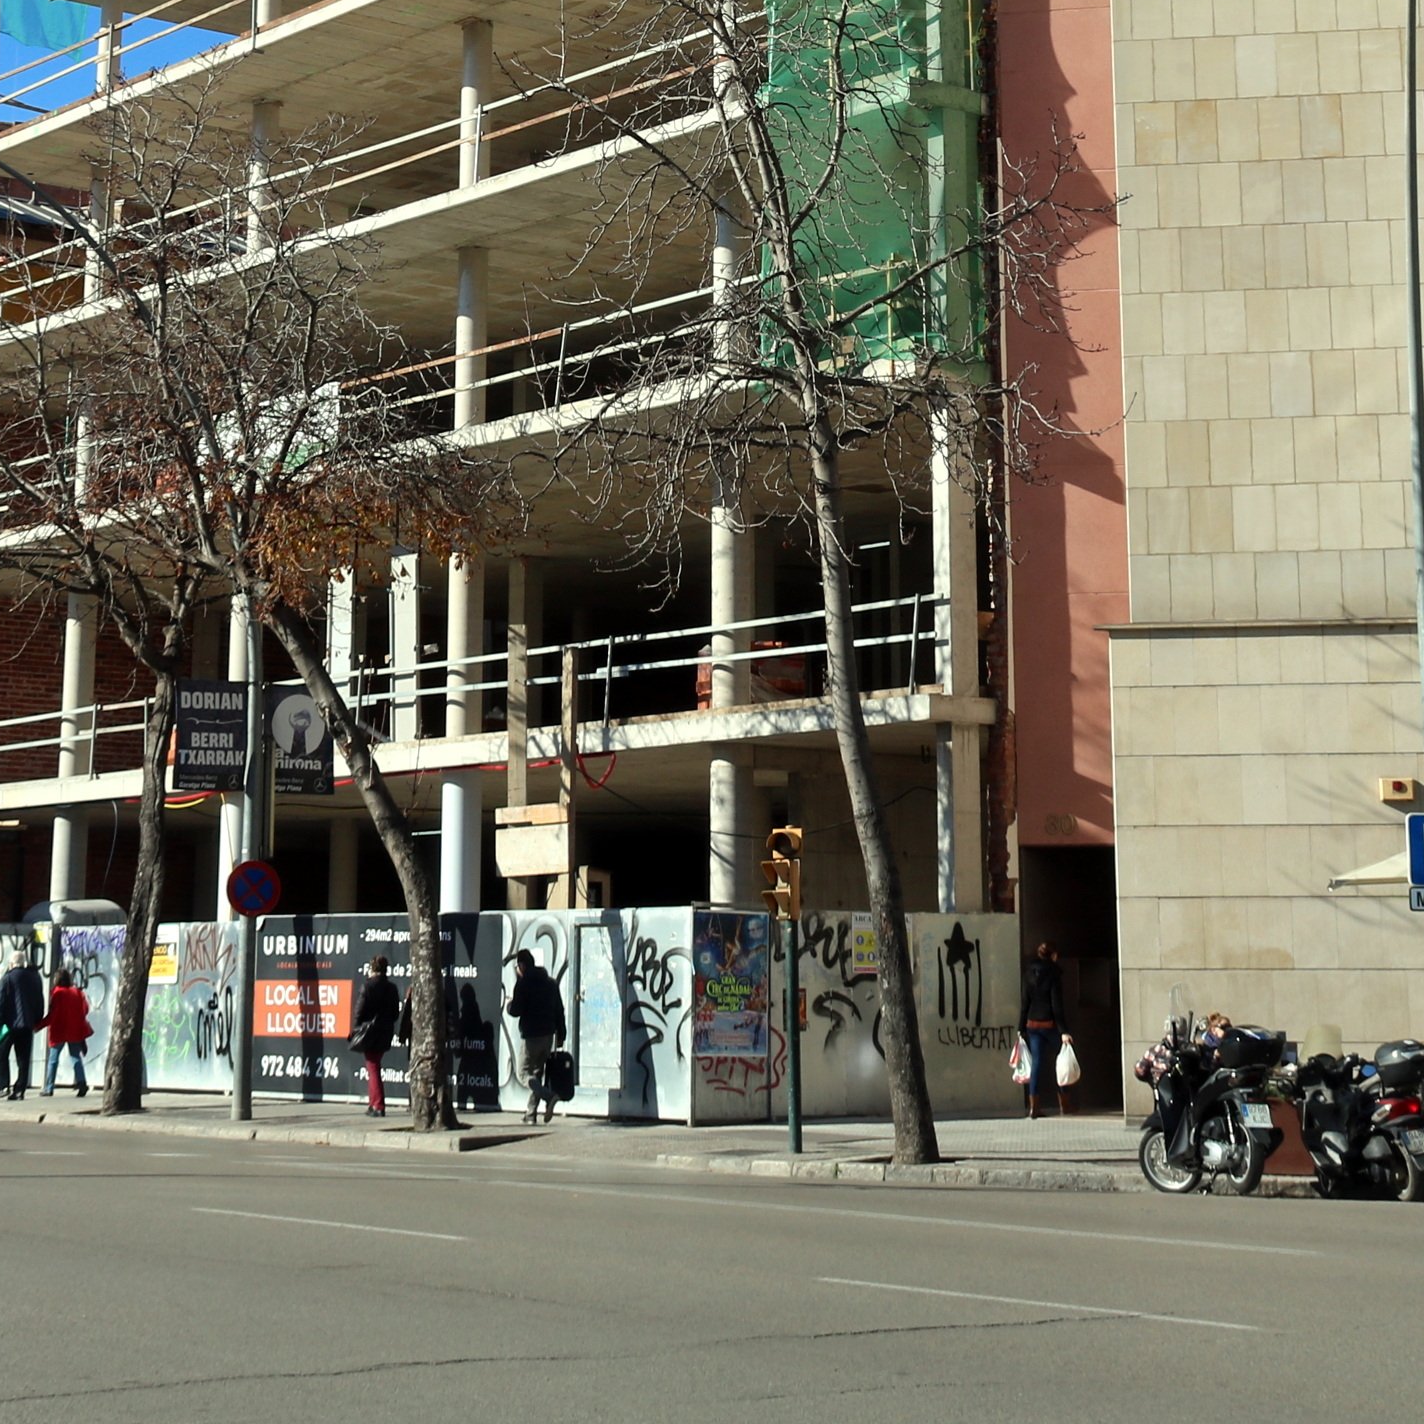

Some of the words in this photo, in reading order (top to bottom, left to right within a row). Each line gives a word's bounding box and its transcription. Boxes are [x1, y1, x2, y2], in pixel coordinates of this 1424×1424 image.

[180, 691, 244, 711] DORIAN
[191, 732, 234, 748] BERRI
[178, 749, 245, 766] TXARRAK
[263, 934, 349, 955] URBINIUM
[265, 984, 314, 1005] LOCAL
[318, 985, 338, 1005] EN
[266, 1012, 336, 1033] LLOGUER
[938, 1025, 1013, 1051] LLIBERTAT
[261, 1055, 284, 1077] 972
[286, 1056, 311, 1077] 484
[315, 1057, 339, 1079] 294
